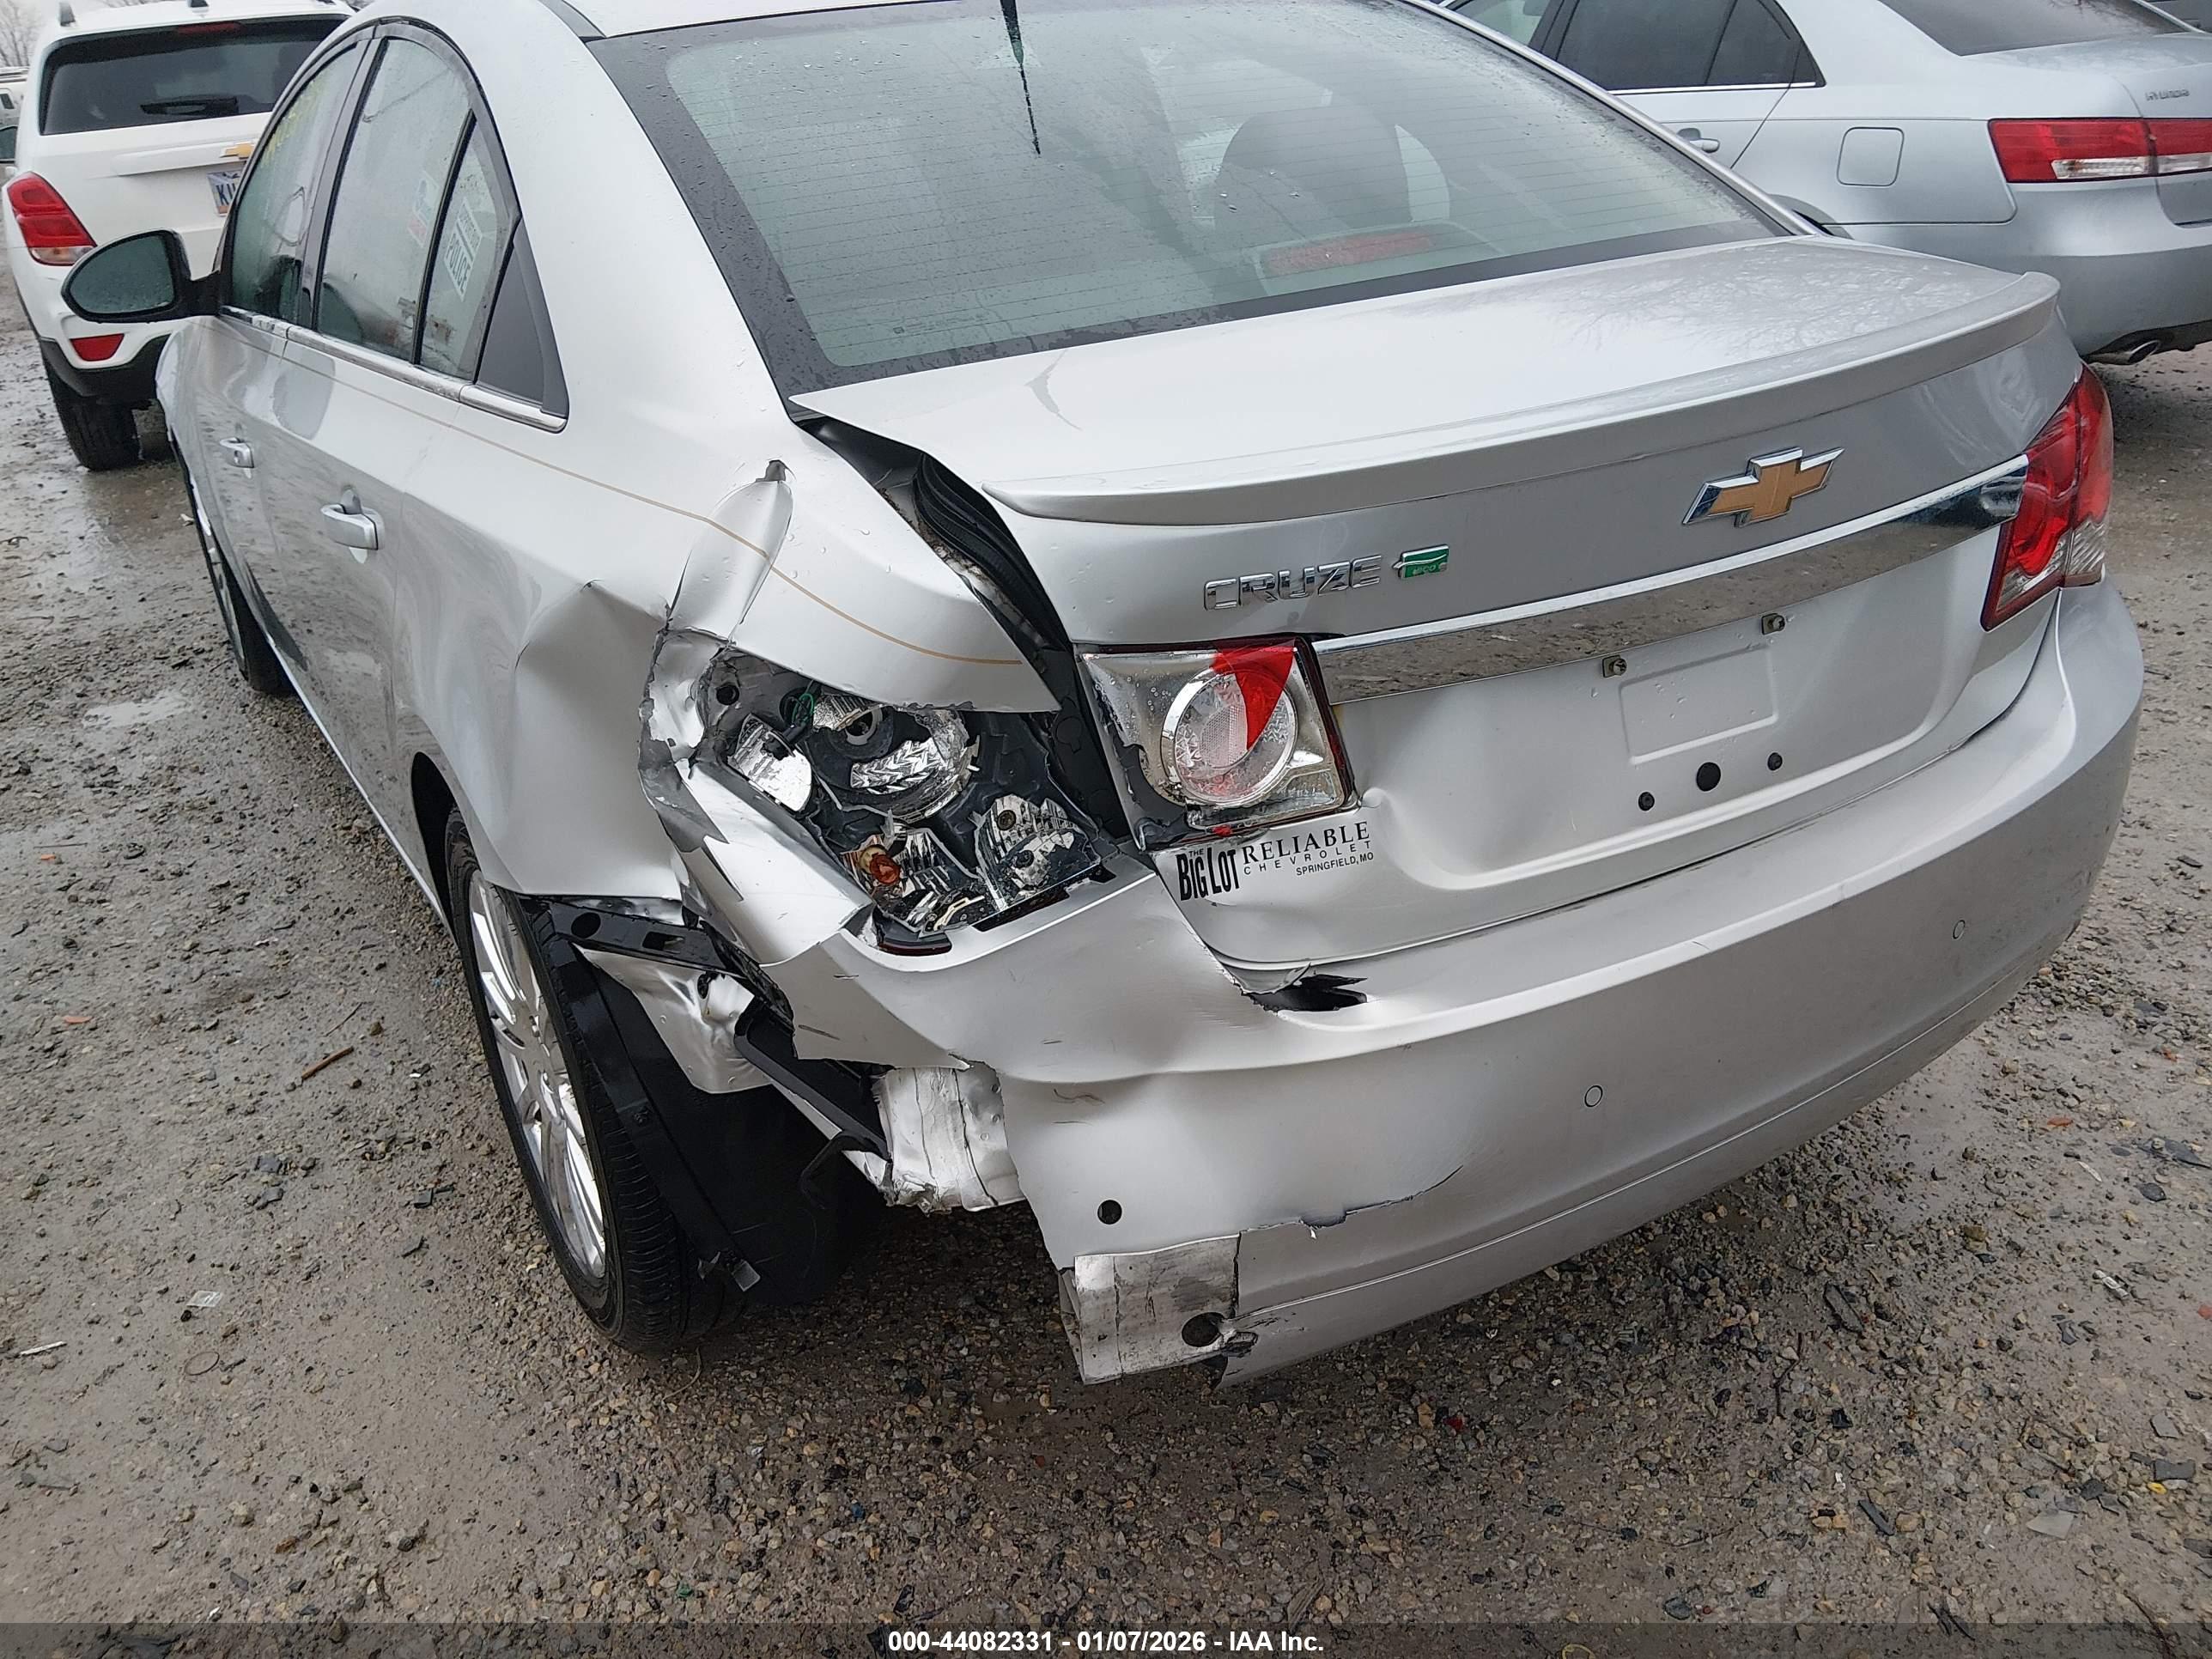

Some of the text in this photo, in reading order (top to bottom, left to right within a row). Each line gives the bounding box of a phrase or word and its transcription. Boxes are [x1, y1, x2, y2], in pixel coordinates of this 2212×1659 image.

[446, 232, 471, 295] POLICE
[1204, 555, 1381, 611] CRUZE
[1188, 848, 1205, 857] THE
[1242, 821, 1370, 865] RELIABLE
[1243, 841, 1370, 875] CHEVROLET
[1296, 852, 1374, 876] SPRINGFIELD, MO
[1176, 847, 1239, 901] BIG LOT
